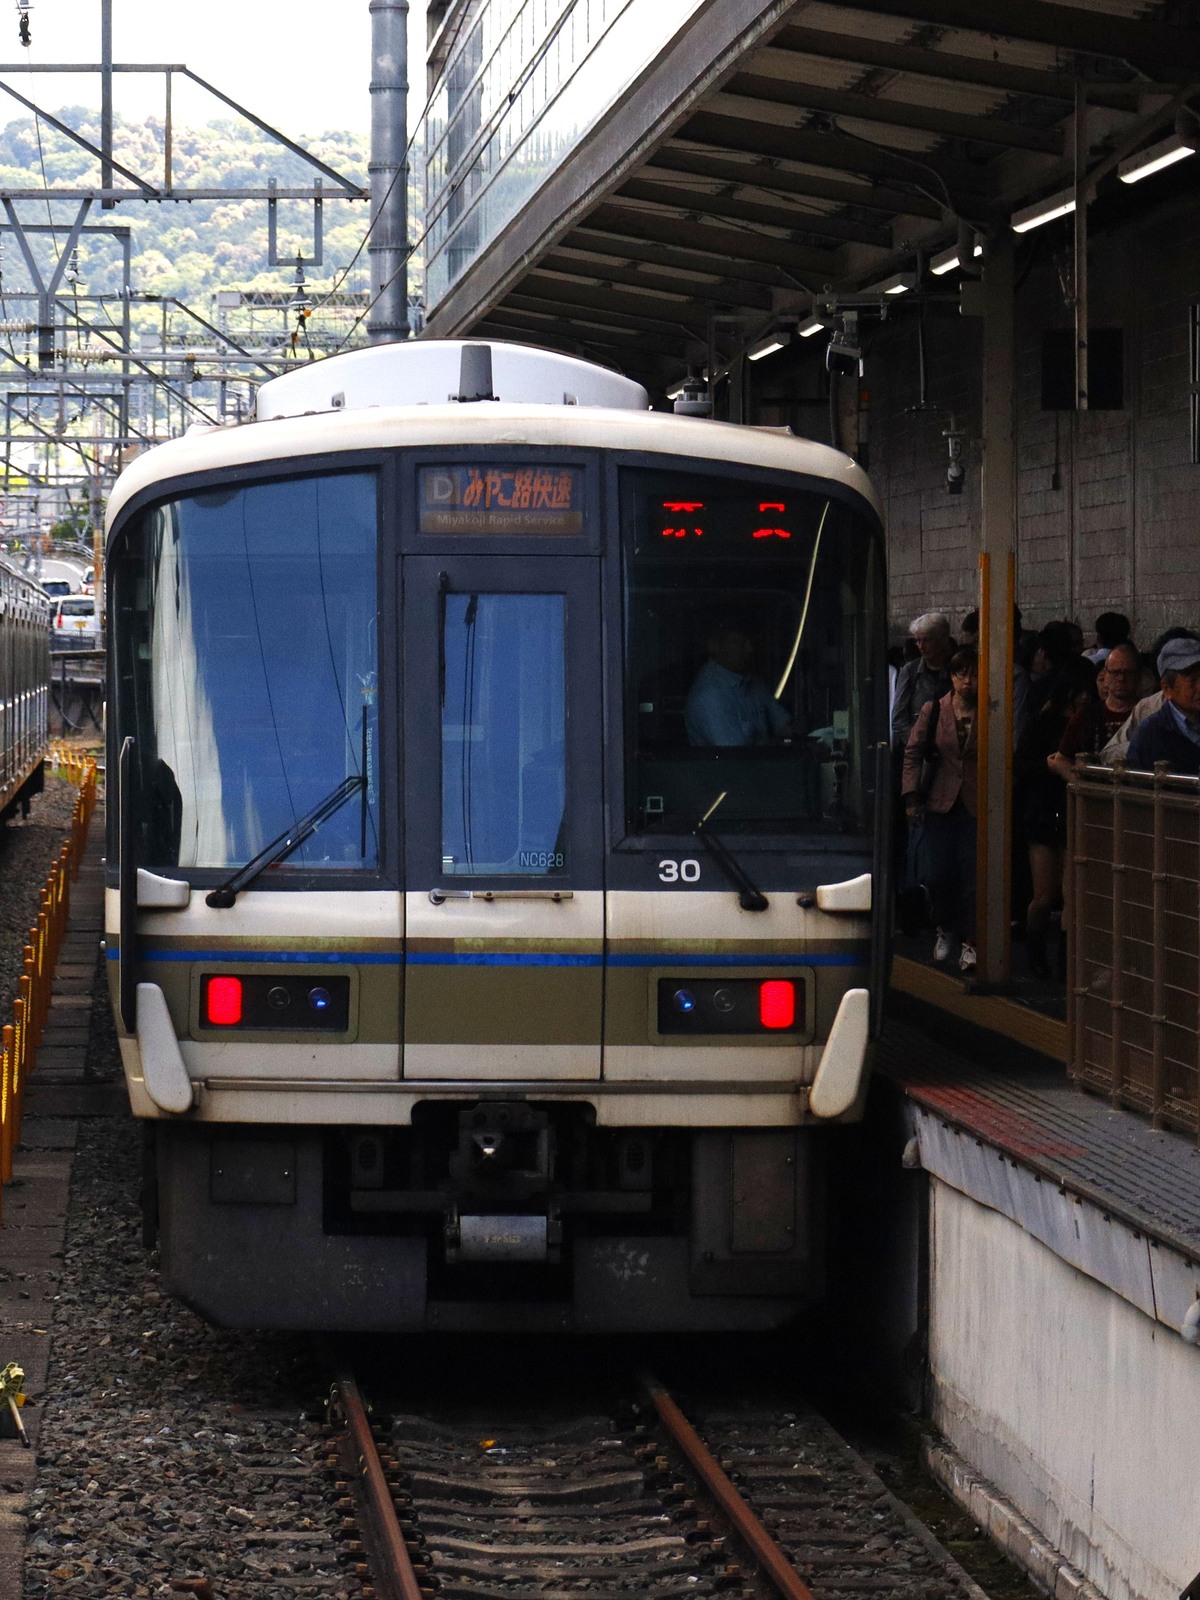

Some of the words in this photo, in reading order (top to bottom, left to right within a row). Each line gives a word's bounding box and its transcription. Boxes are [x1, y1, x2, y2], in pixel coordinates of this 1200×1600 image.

[433, 475, 454, 500] D
[462, 467, 573, 508] みやこ路快速
[437, 514, 487, 527] Miyakoji
[489, 514, 522, 527] Rapid
[525, 514, 565, 525] Service
[519, 851, 564, 867] NC628
[658, 858, 701, 884] 30
